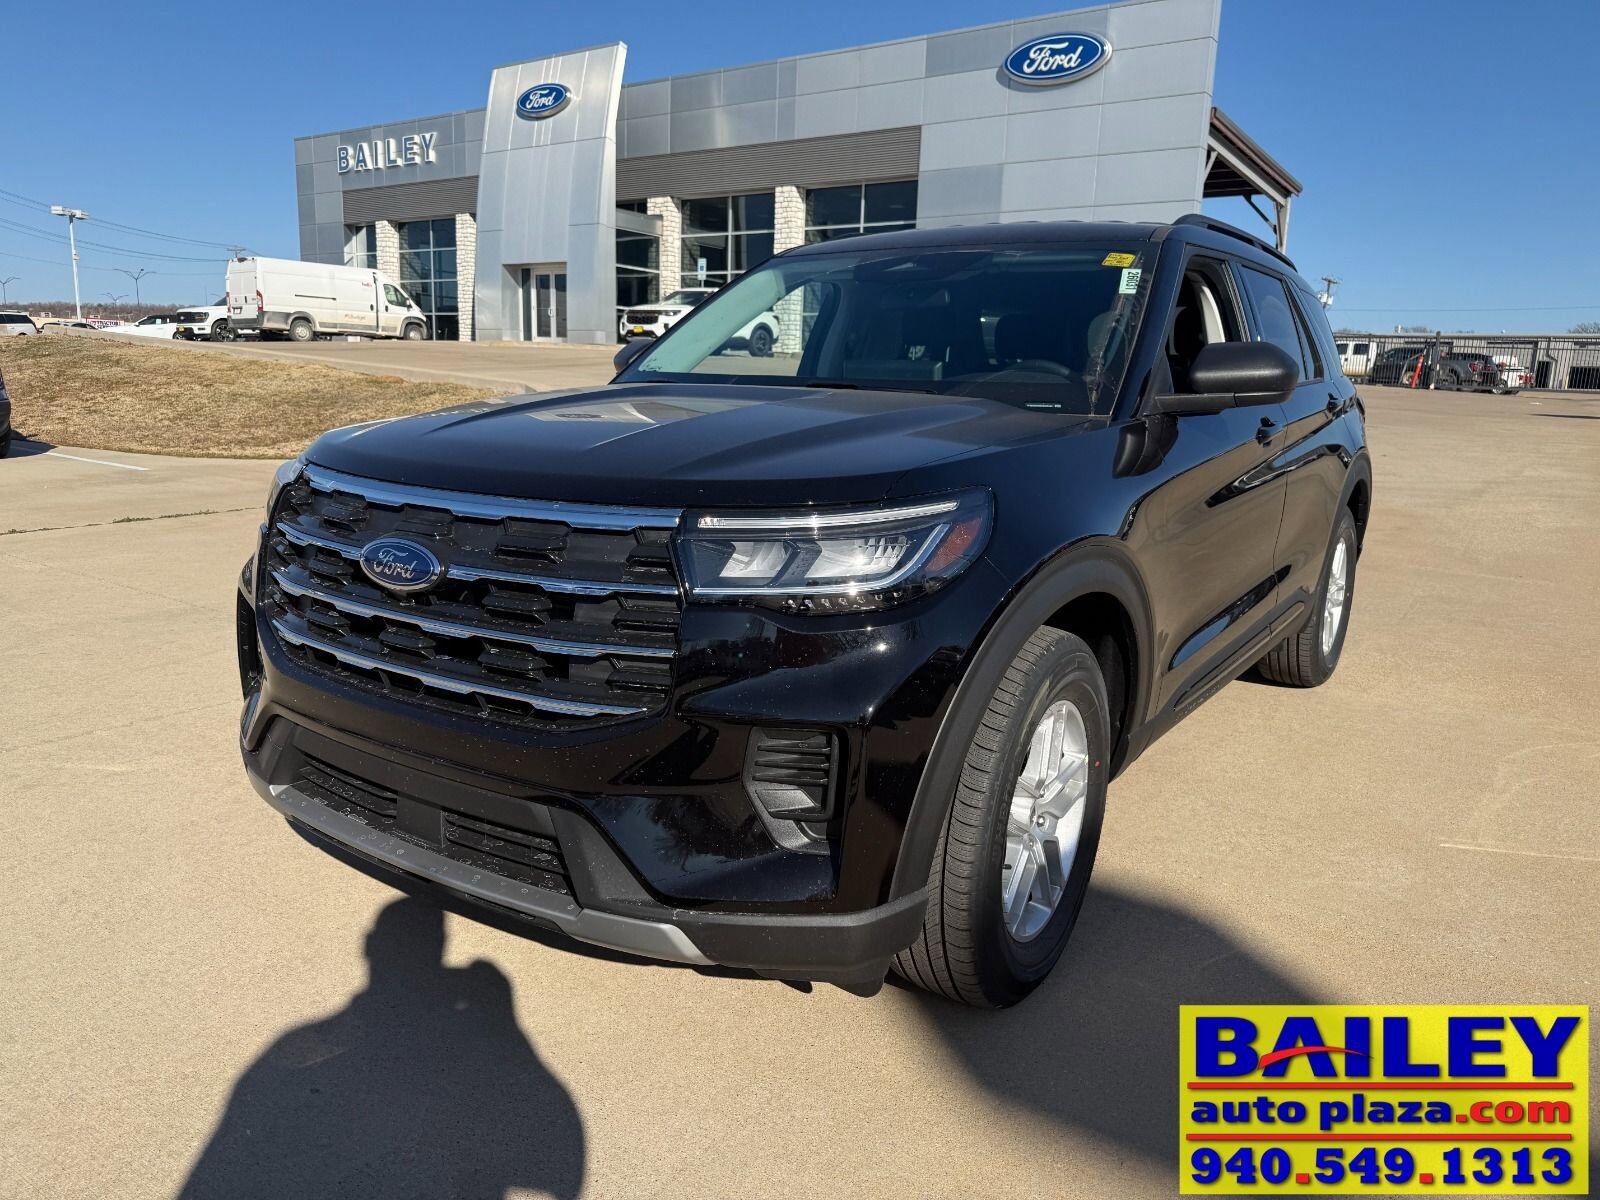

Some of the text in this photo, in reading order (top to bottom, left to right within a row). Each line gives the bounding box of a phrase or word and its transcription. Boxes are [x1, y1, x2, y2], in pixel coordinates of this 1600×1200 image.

[1022, 41, 1084, 74] Ford
[525, 89, 556, 109] Ford
[336, 131, 438, 174] BAILEY
[373, 547, 418, 579] Ford
